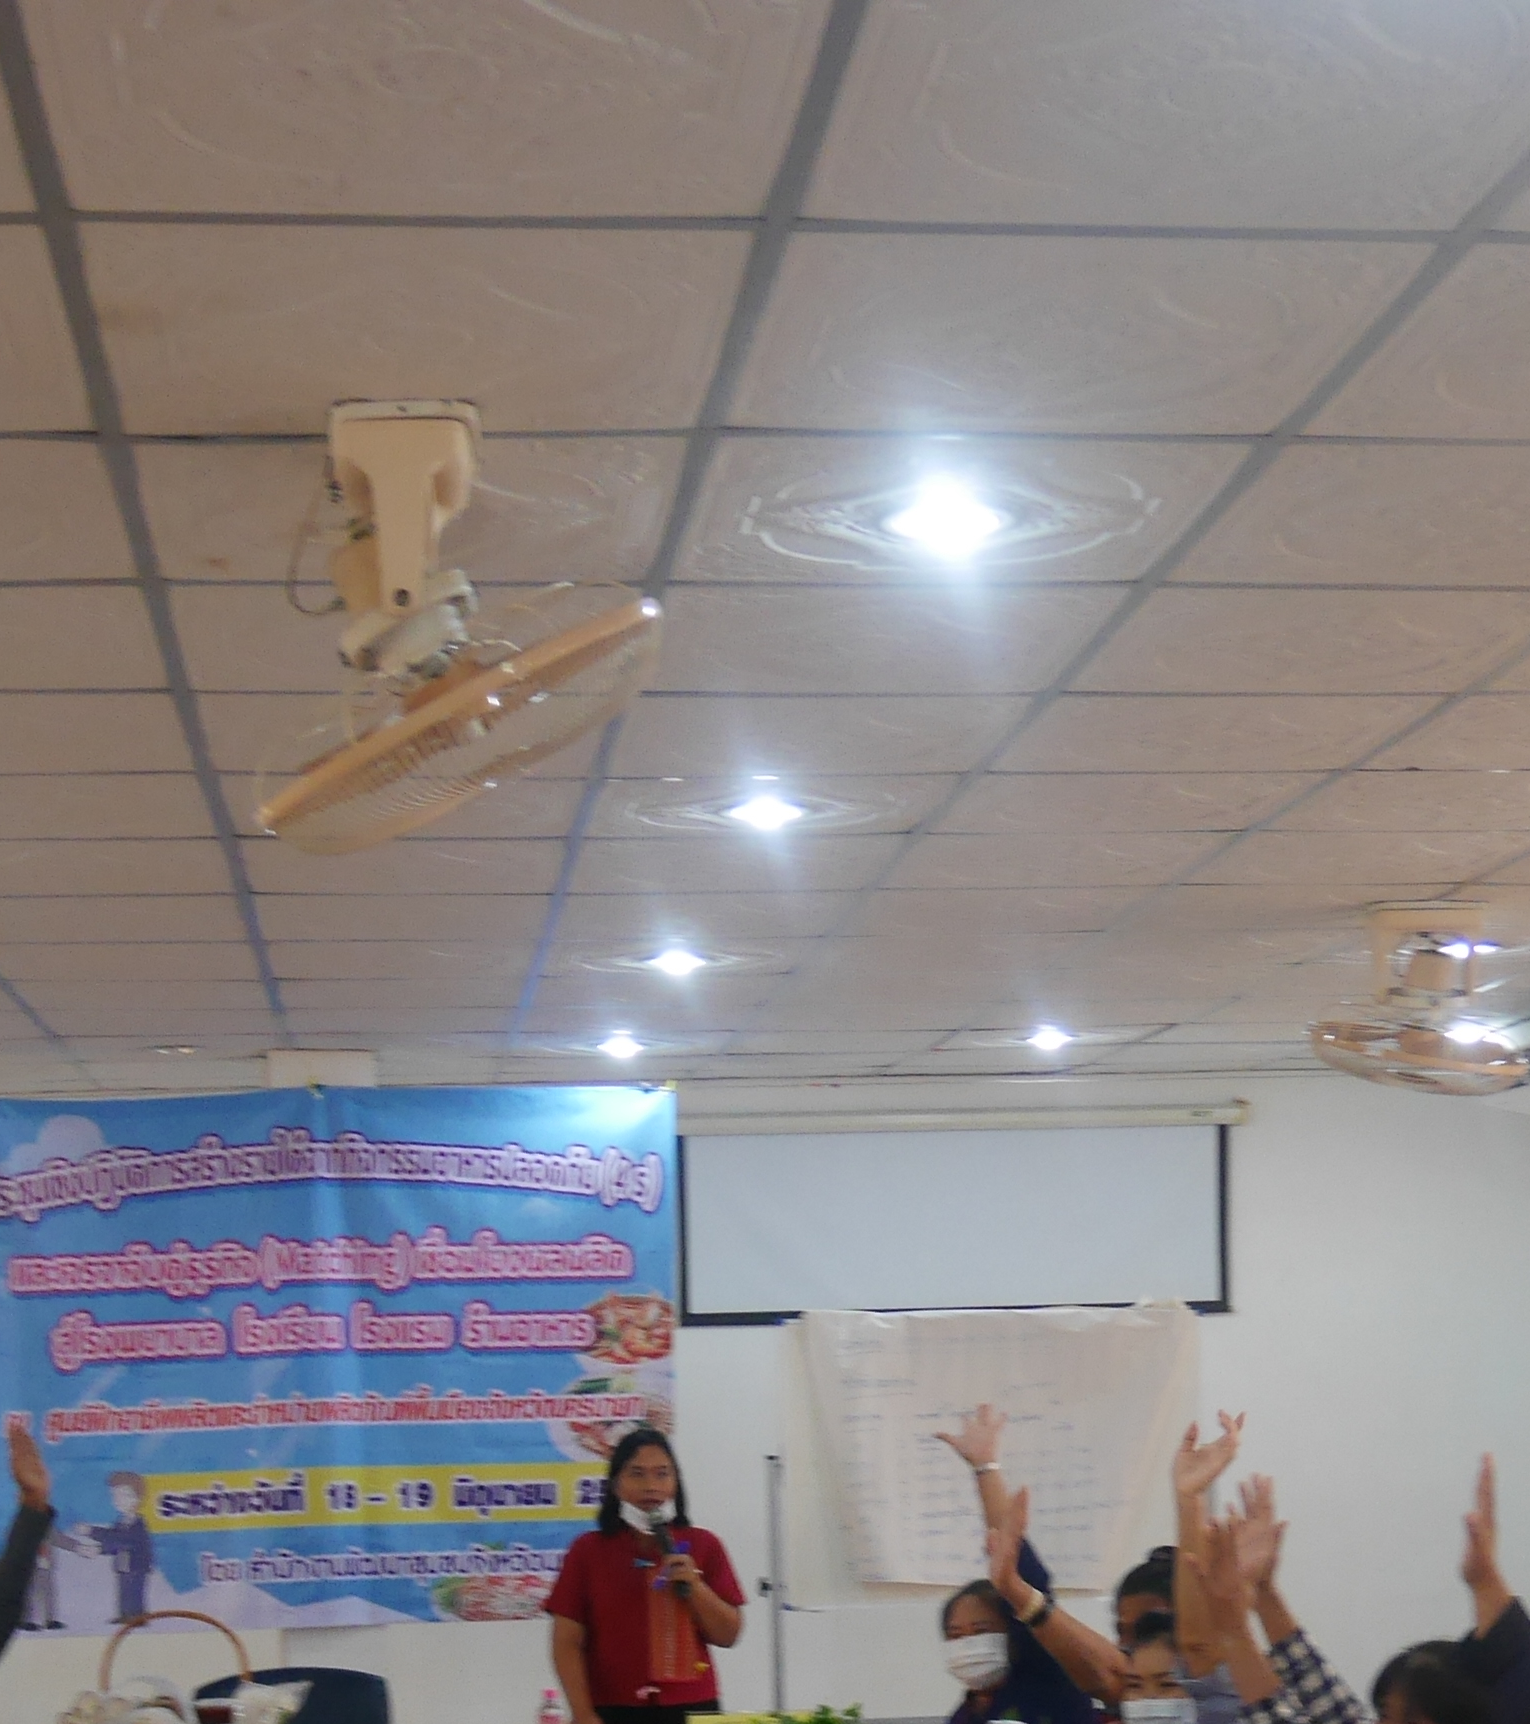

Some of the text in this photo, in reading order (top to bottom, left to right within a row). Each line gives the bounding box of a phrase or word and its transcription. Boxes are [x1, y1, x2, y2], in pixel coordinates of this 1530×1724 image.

[231, 1302, 348, 1355] โรงเรียน
[349, 1299, 455, 1351] โรงแรม
[459, 1300, 599, 1352] ร้านอาหาร
[158, 1470, 307, 1518] ระหว่างวันที่
[395, 1479, 436, 1511] 19
[452, 1476, 559, 1519] มิถุนายน
[244, 1542, 566, 1587] สำนักงานพัฒนาชุมชนจังหวัดน
